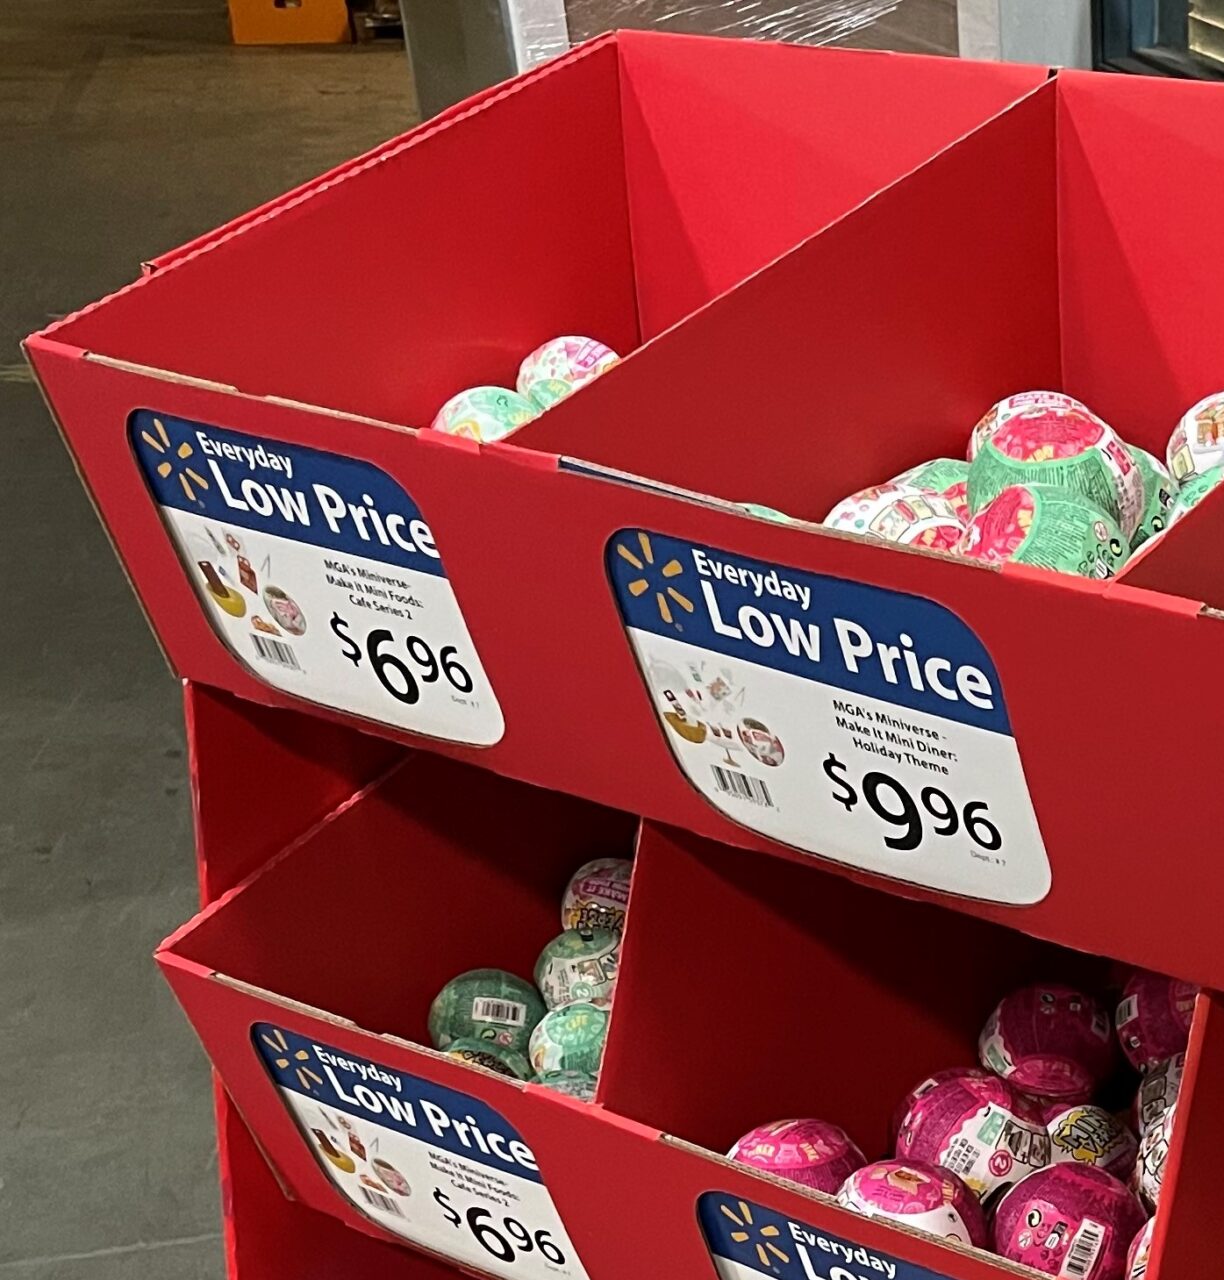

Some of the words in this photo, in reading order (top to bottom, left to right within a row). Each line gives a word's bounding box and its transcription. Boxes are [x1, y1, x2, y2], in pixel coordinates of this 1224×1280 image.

[196, 431, 293, 479] Everyday
[208, 459, 310, 527] Low
[313, 484, 441, 559] Price
[692, 549, 811, 611] Everyday
[701, 580, 820, 662] Low
[834, 618, 994, 710] Price
[833, 700, 873, 721] MGA's
[875, 712, 940, 740] Miniverse
[835, 716, 871, 736] Make
[872, 727, 884, 740] It
[886, 731, 915, 749] Mini
[917, 740, 958, 762] Diner:
[852, 737, 902, 764] Holiday
[903, 752, 949, 775] Theme
[313, 1045, 402, 1092] Everyday
[323, 1065, 417, 1127] Low
[420, 1100, 540, 1171] Price
[788, 1222, 896, 1279] Everyday
